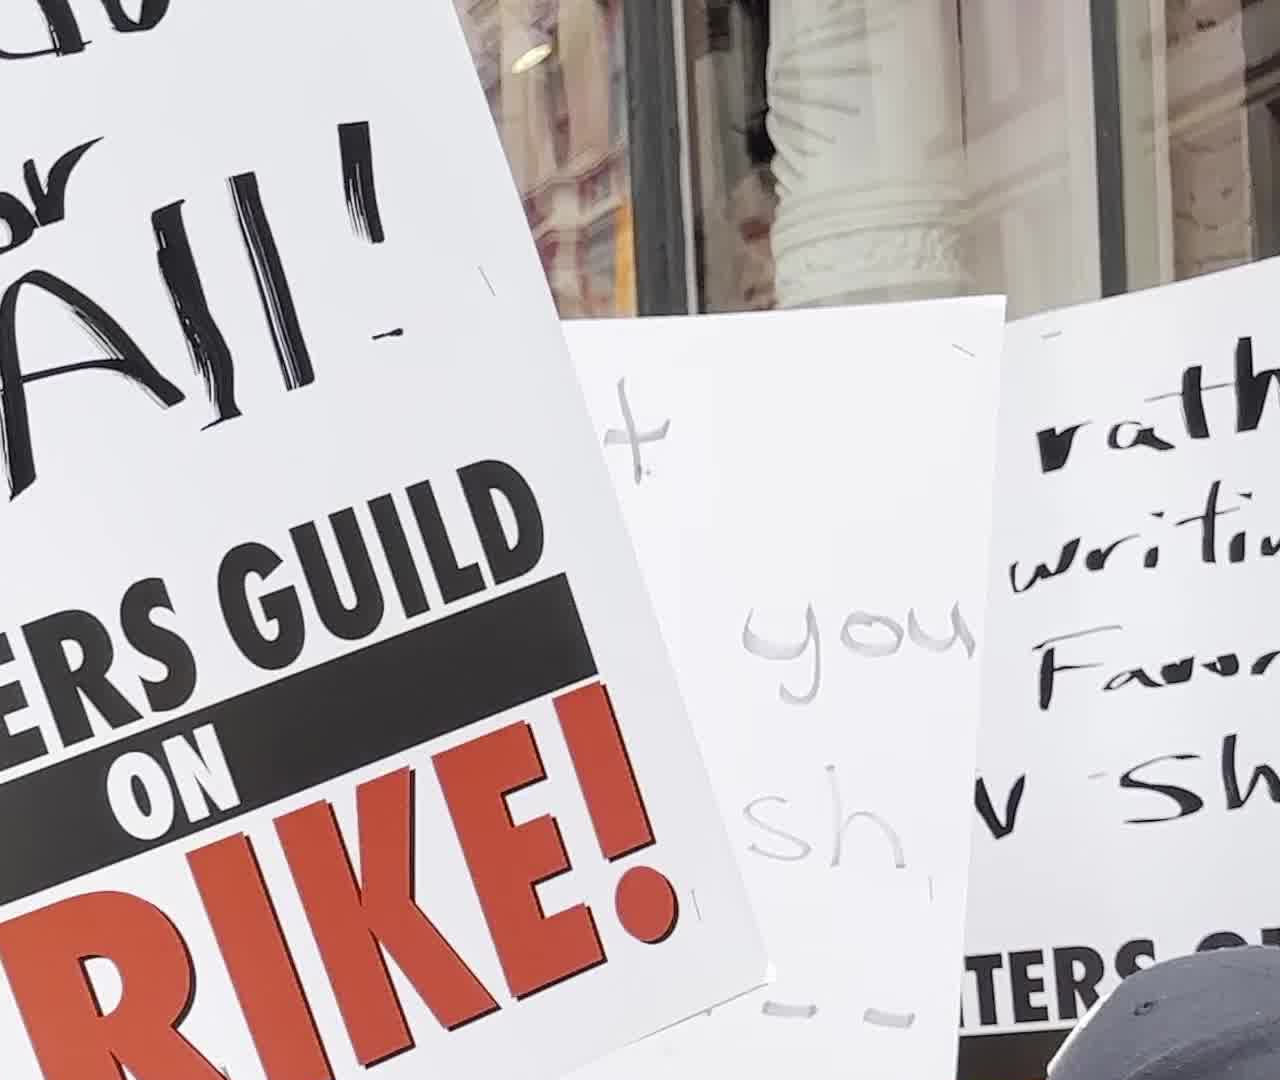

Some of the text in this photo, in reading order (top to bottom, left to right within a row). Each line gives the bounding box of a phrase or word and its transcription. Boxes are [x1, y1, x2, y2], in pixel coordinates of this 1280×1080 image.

[216, 458, 545, 671] GUILD
[742, 600, 977, 706] you
[106, 723, 239, 841] ON
